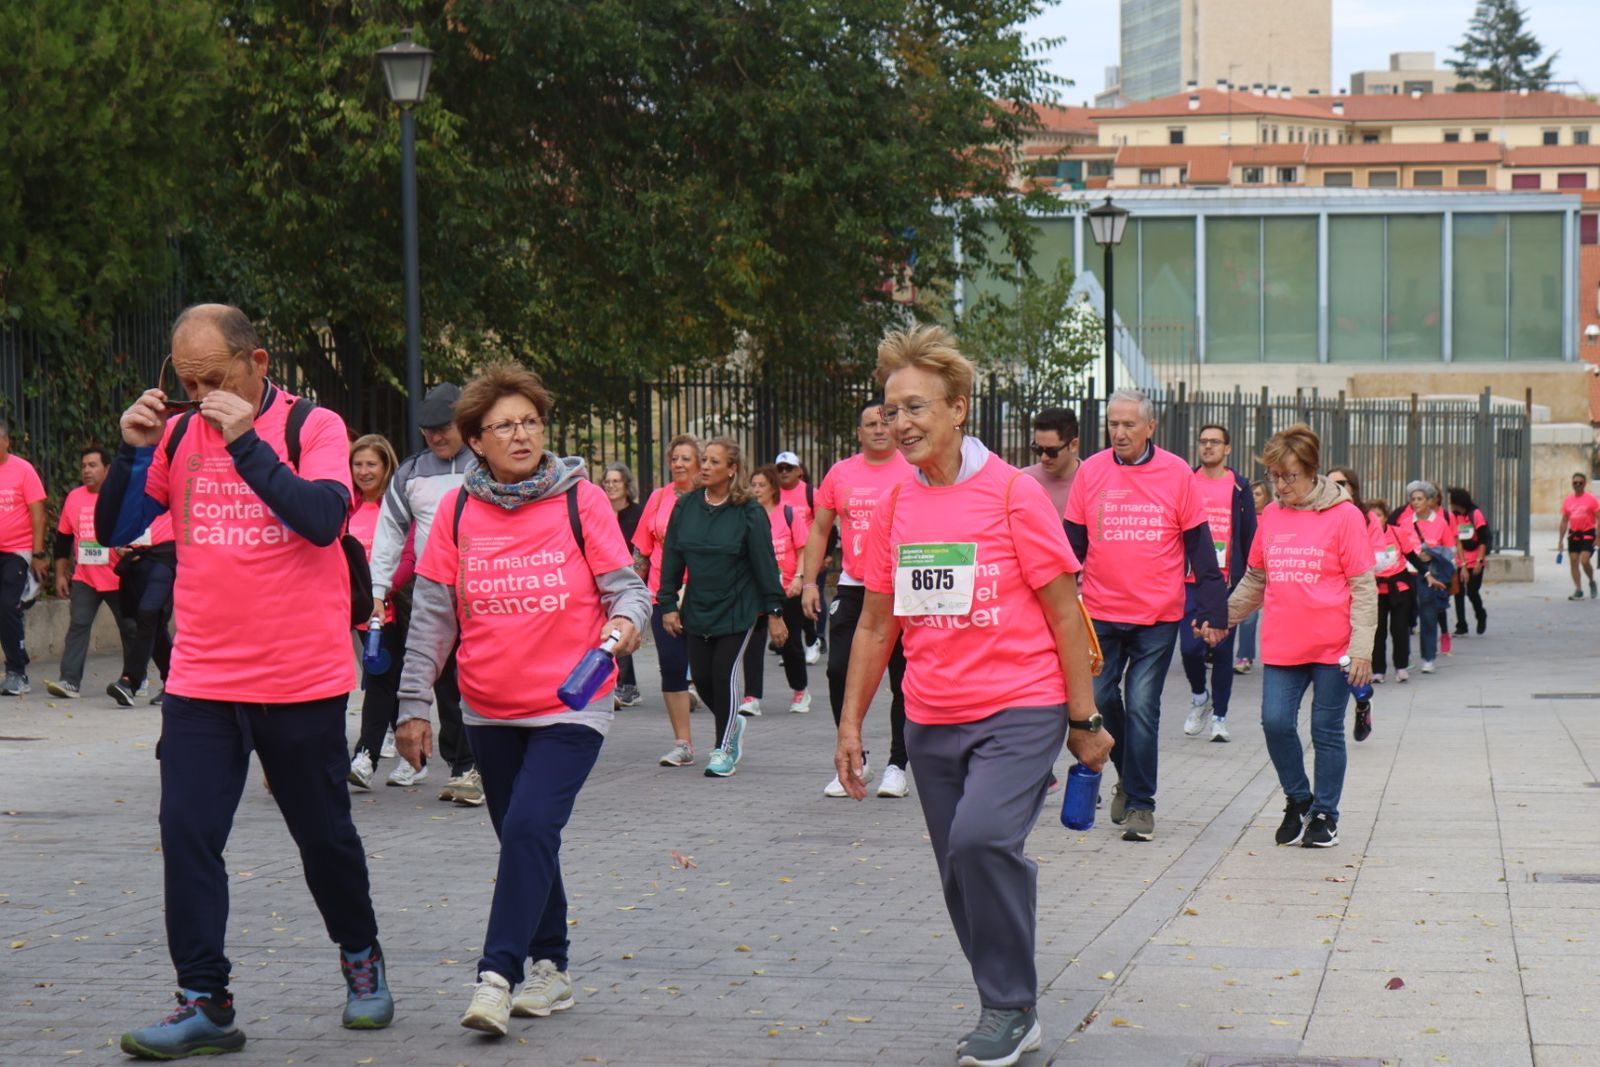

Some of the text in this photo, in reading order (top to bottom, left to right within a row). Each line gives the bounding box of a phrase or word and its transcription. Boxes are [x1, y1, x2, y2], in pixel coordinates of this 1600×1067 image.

[195, 477, 218, 495] En
[192, 500, 264, 520] contra
[849, 498, 863, 507] En
[1104, 502, 1164, 514] En marcha
[1103, 514, 1164, 527] contra el
[1103, 526, 1164, 541] cáncer
[1268, 545, 1324, 557] En marcha
[467, 549, 566, 571] En marcha
[1267, 559, 1322, 571] contra el
[467, 567, 567, 594] contra el
[911, 568, 955, 591] 8675
[1268, 568, 1321, 584] cáncer
[976, 580, 999, 602] el
[472, 592, 571, 616] cáncer
